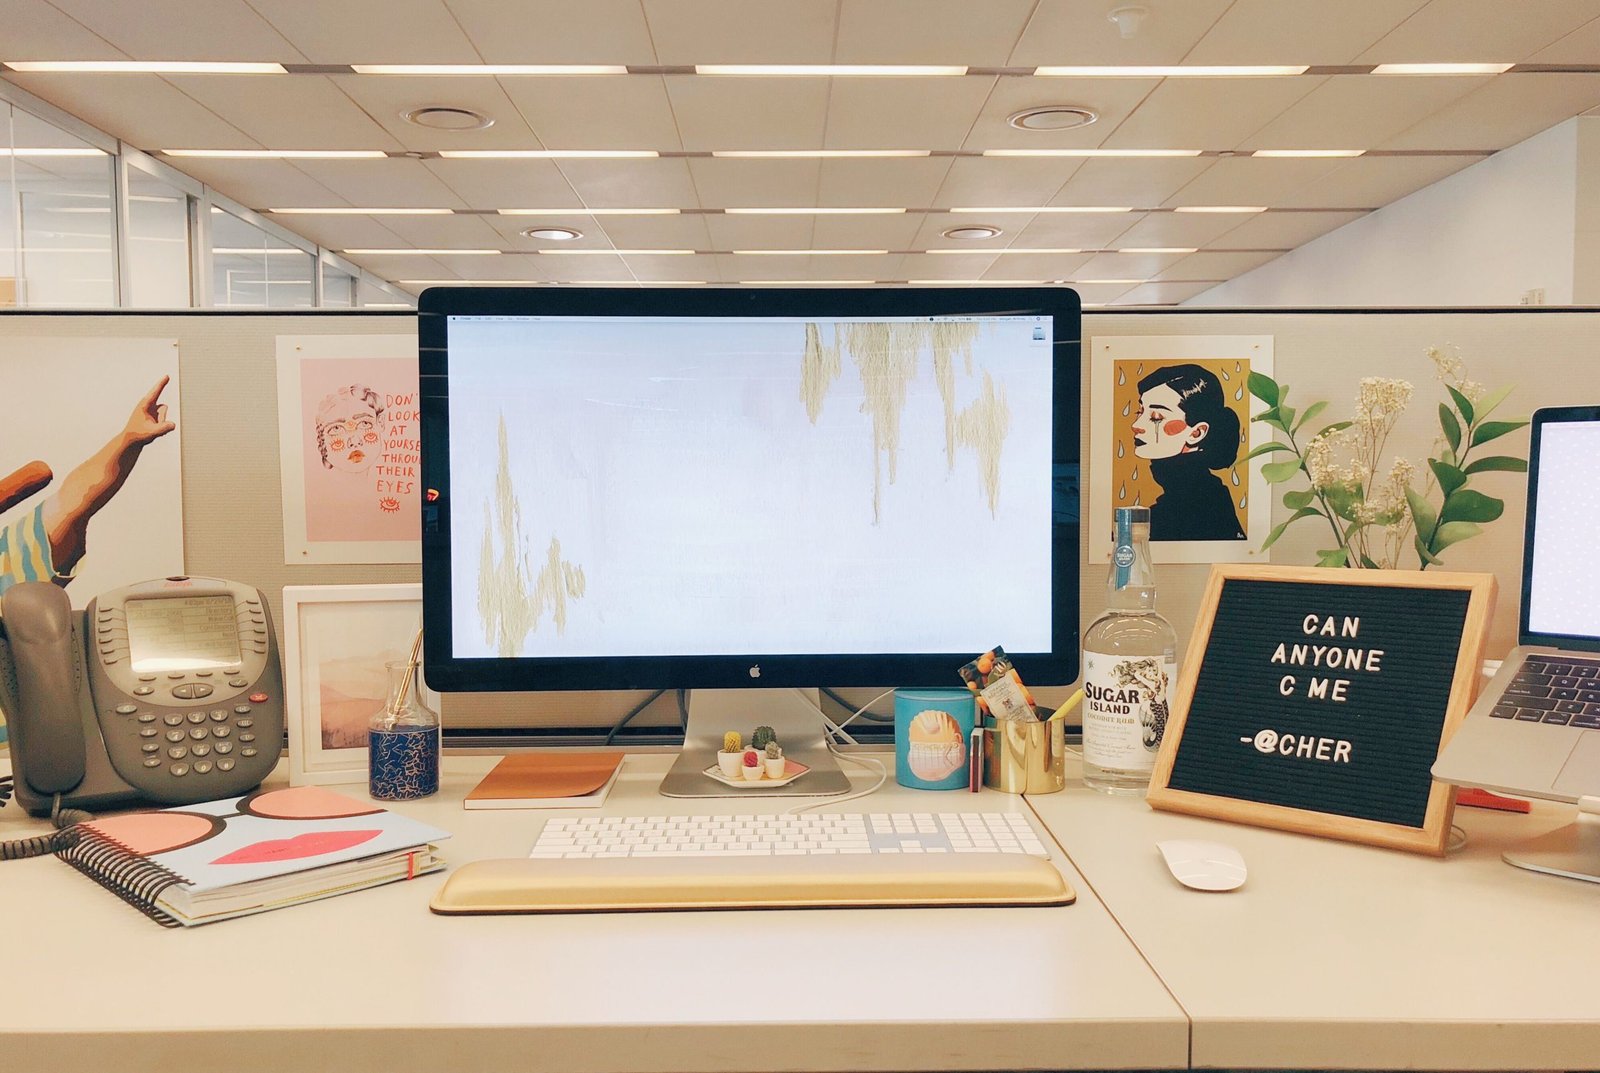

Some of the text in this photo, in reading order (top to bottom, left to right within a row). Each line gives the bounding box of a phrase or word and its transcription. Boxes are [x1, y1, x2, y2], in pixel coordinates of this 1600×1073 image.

[386, 393, 418, 408] DON'
[388, 411, 420, 421] LOOK
[390, 425, 407, 436] AT
[383, 439, 420, 451] YOURSE
[382, 454, 420, 463] THROU
[376, 465, 415, 477] THEIR
[376, 480, 414, 494] EYES
[1303, 614, 1360, 638] CAN
[1270, 643, 1384, 671] ANYONE
[1085, 682, 1140, 704] SUGAR
[1279, 675, 1350, 701] C ME
[1090, 701, 1130, 715] ISLAND
